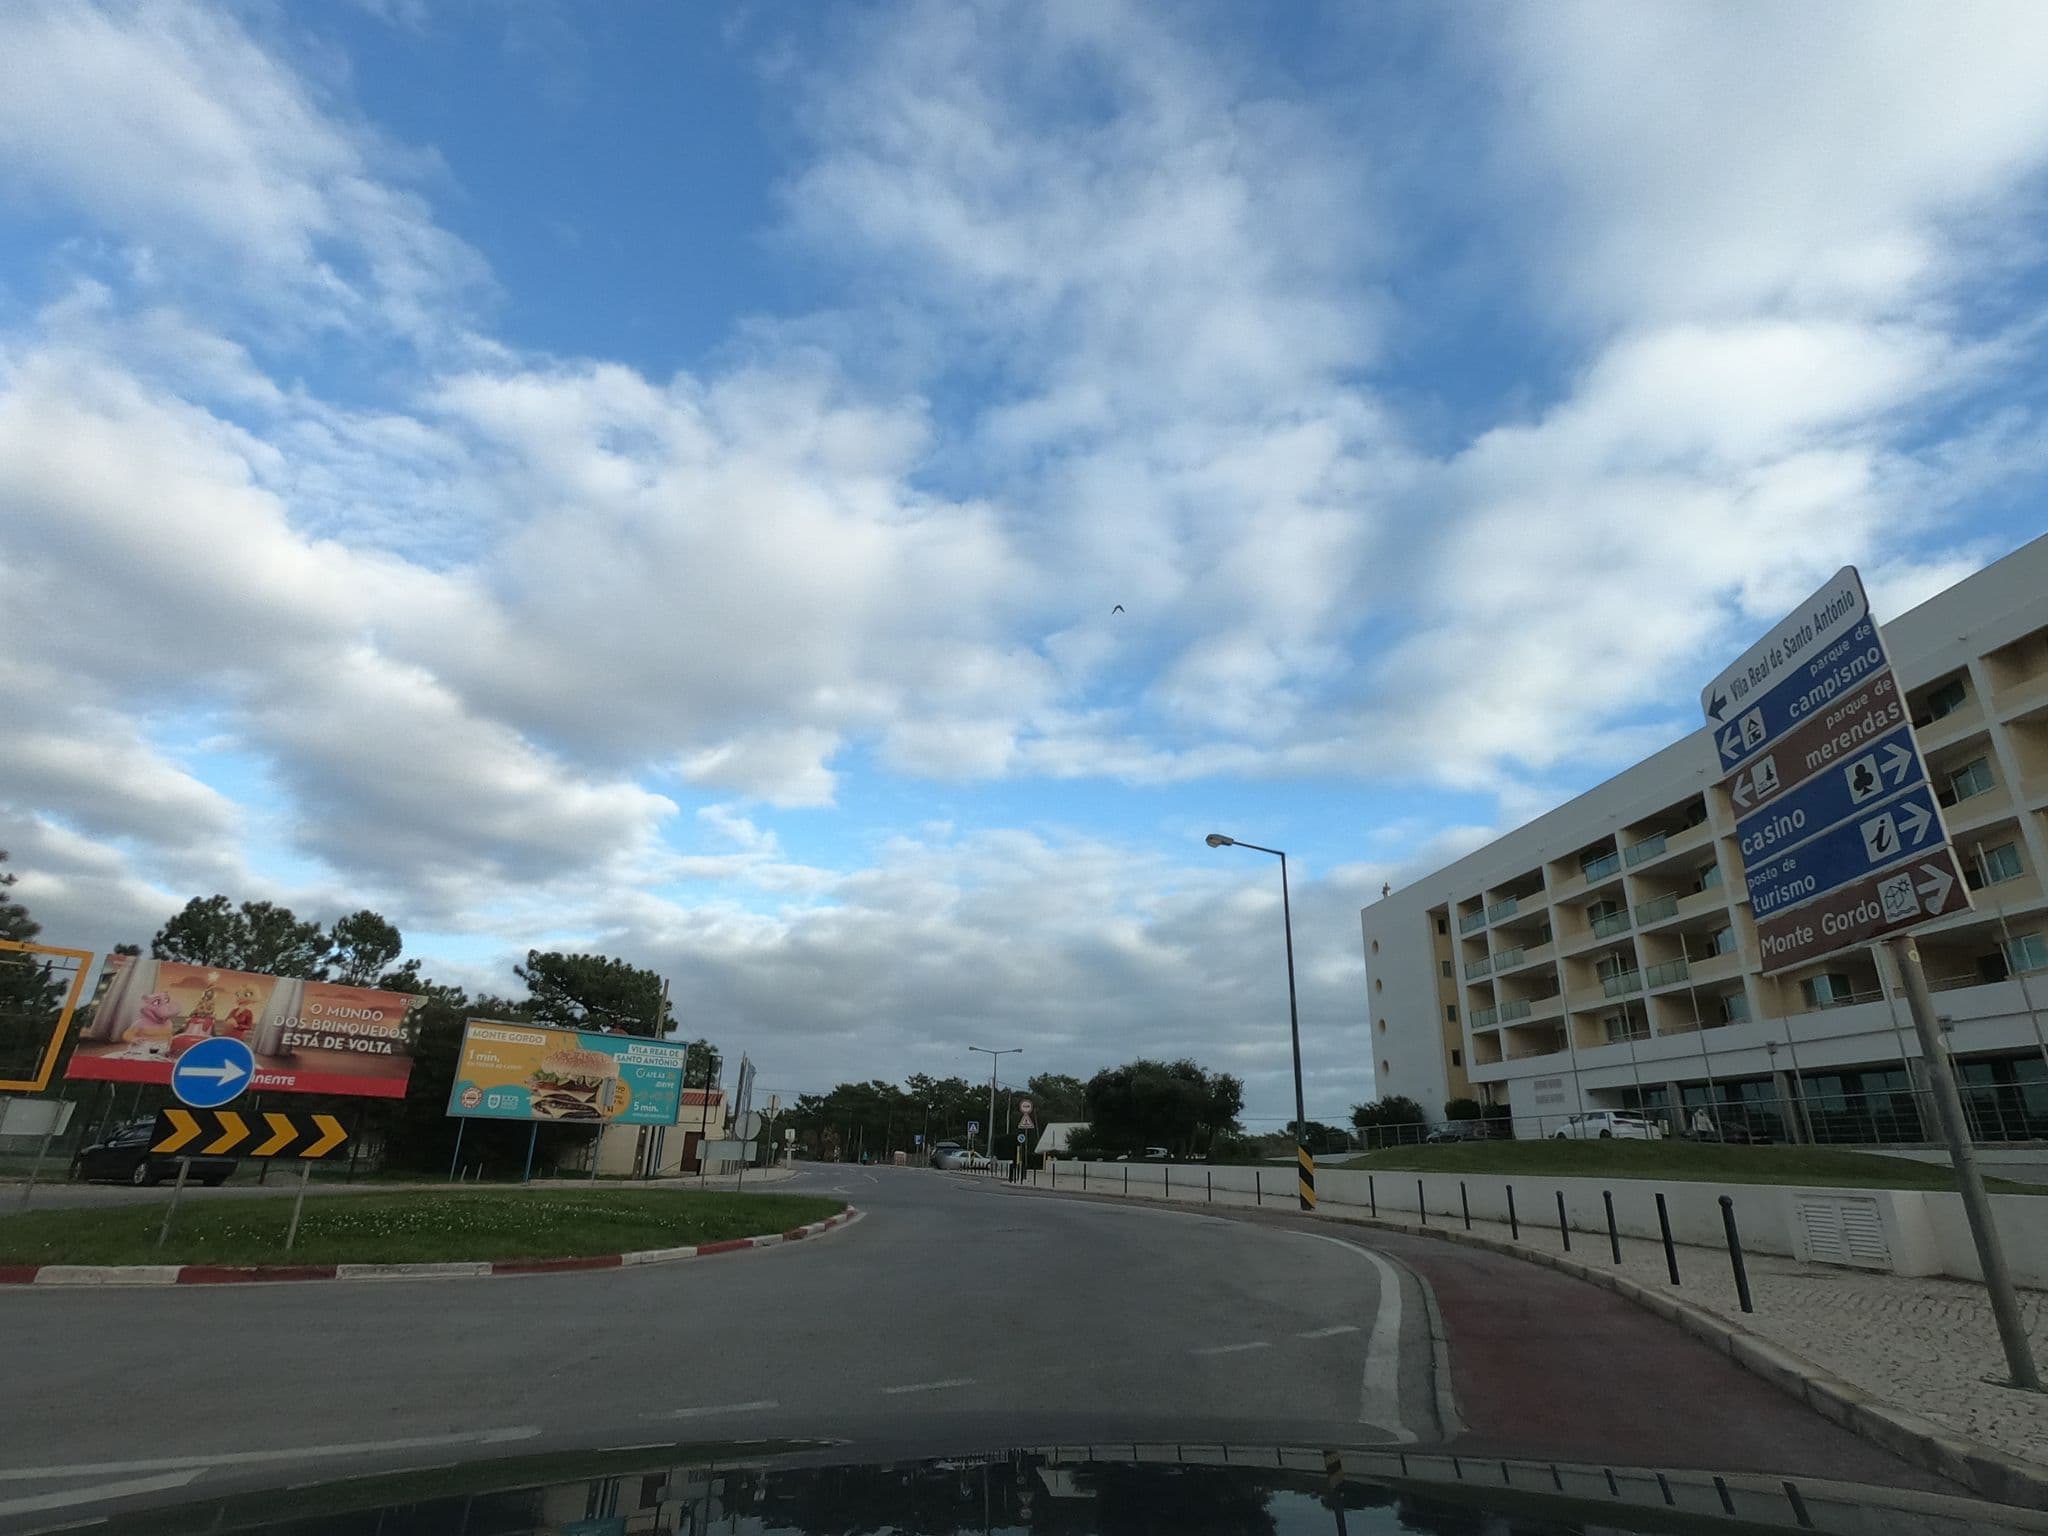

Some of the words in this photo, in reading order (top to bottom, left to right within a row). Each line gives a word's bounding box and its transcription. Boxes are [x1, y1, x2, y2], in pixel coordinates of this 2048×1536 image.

[1730, 676, 1749, 701] Vila
[1748, 655, 1771, 687] Real
[1771, 648, 1784, 668] de
[1782, 624, 1811, 658] Santo
[1813, 590, 1855, 636] António
[1810, 640, 1850, 676] parque
[1855, 624, 1871, 641] de
[1789, 647, 1880, 718] campismo
[1826, 693, 1868, 730] parque
[1874, 680, 1892, 696] de
[1805, 702, 1900, 769] merendas
[1742, 809, 1805, 855] casino
[1748, 865, 1778, 889] posto
[1783, 858, 1797, 872] de
[1752, 875, 1816, 912] turismo
[1761, 926, 1814, 958] Monte
[1821, 900, 1881, 936] Gordo
[272, 1015, 307, 1029] DOS
[311, 1019, 408, 1040] BRINQUEDOS
[311, 1004, 322, 1014] O
[326, 1007, 383, 1021] MUNDO
[281, 1031, 320, 1048] ESTÁ
[323, 1036, 345, 1050] DE
[348, 1039, 392, 1055] VOLTA
[472, 1029, 506, 1040] MONTE
[508, 1034, 543, 1044] GORDO
[633, 1101, 640, 1111] 5
